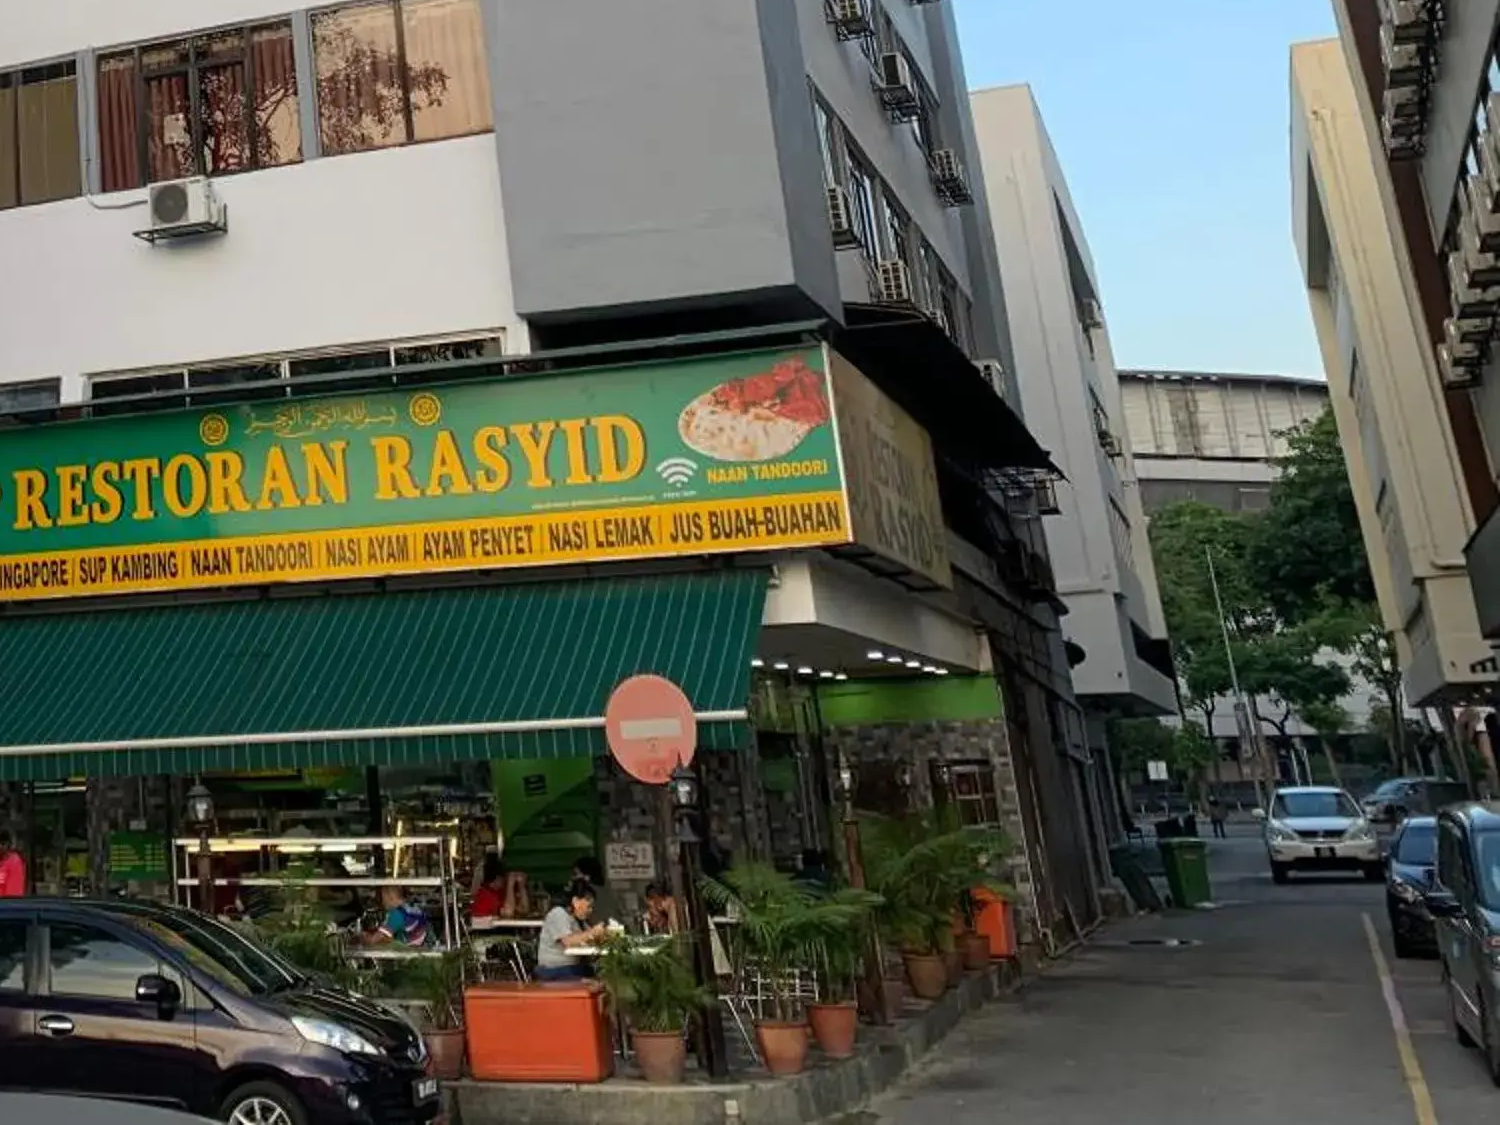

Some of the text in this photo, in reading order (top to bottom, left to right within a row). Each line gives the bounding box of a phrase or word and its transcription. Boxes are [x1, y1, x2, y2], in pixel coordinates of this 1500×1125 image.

[12, 414, 646, 531] RESTORAN RASYID
[79, 557, 107, 586] SUP
[111, 552, 178, 583] KAMBING
[190, 547, 232, 576] NAAN
[235, 539, 314, 573] TANDOORI
[325, 536, 362, 568] NASI
[367, 532, 410, 563] AYAM
[422, 529, 466, 561] AYAM
[470, 524, 535, 556] PENYET
[548, 520, 589, 551] NASI
[594, 515, 654, 548] LEMAK
[669, 511, 703, 544] JUS
[710, 501, 842, 540] BUAH-BUAHAN
